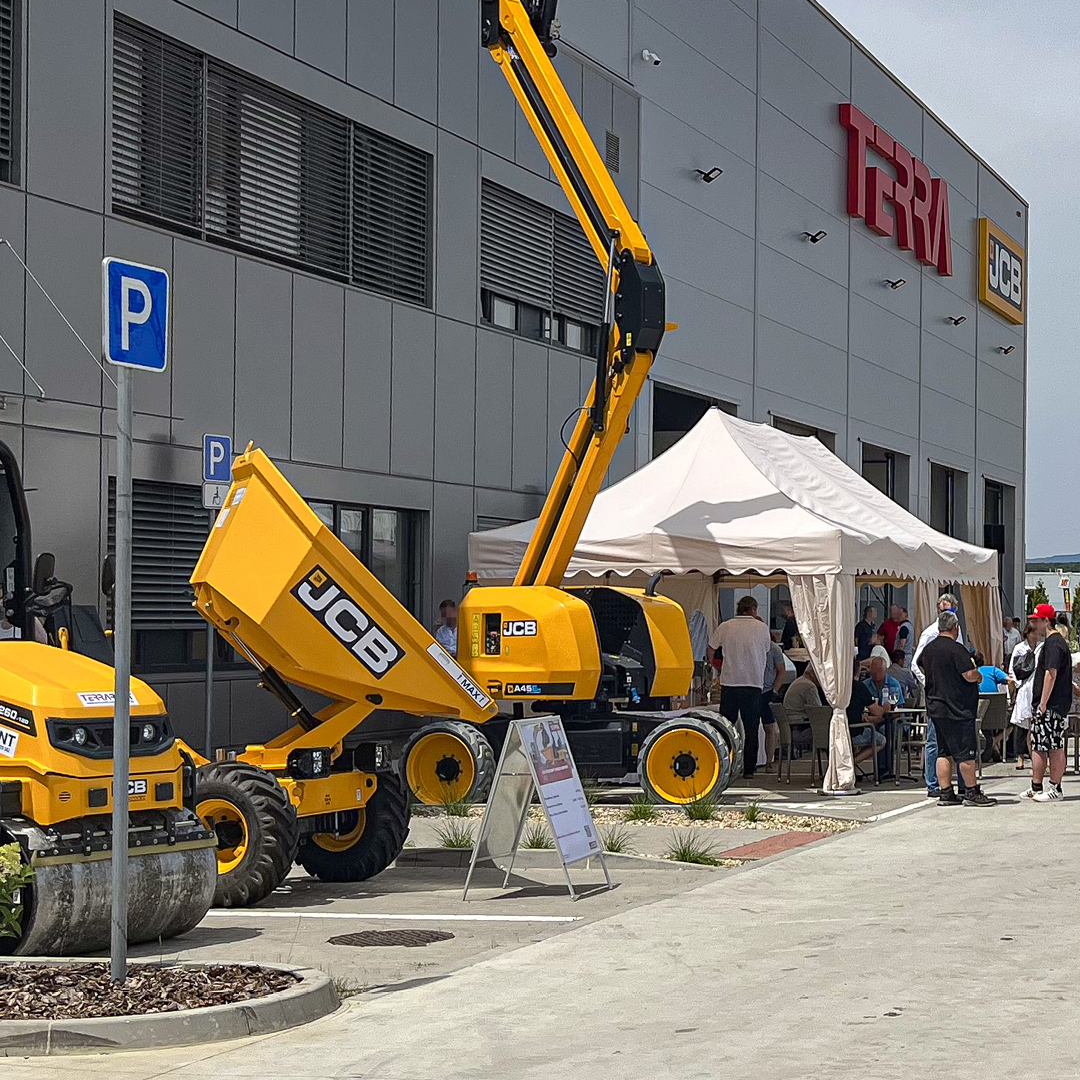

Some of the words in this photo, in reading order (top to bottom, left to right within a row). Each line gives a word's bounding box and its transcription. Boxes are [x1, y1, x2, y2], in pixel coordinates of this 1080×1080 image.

[838, 102, 953, 277] TERRA
[988, 242, 1023, 306] JCB
[121, 275, 152, 351] P
[210, 441, 225, 475] P
[297, 580, 399, 674] JCB
[503, 621, 537, 636] JCB
[461, 679, 480, 699] MAX
[126, 780, 147, 794] CB
